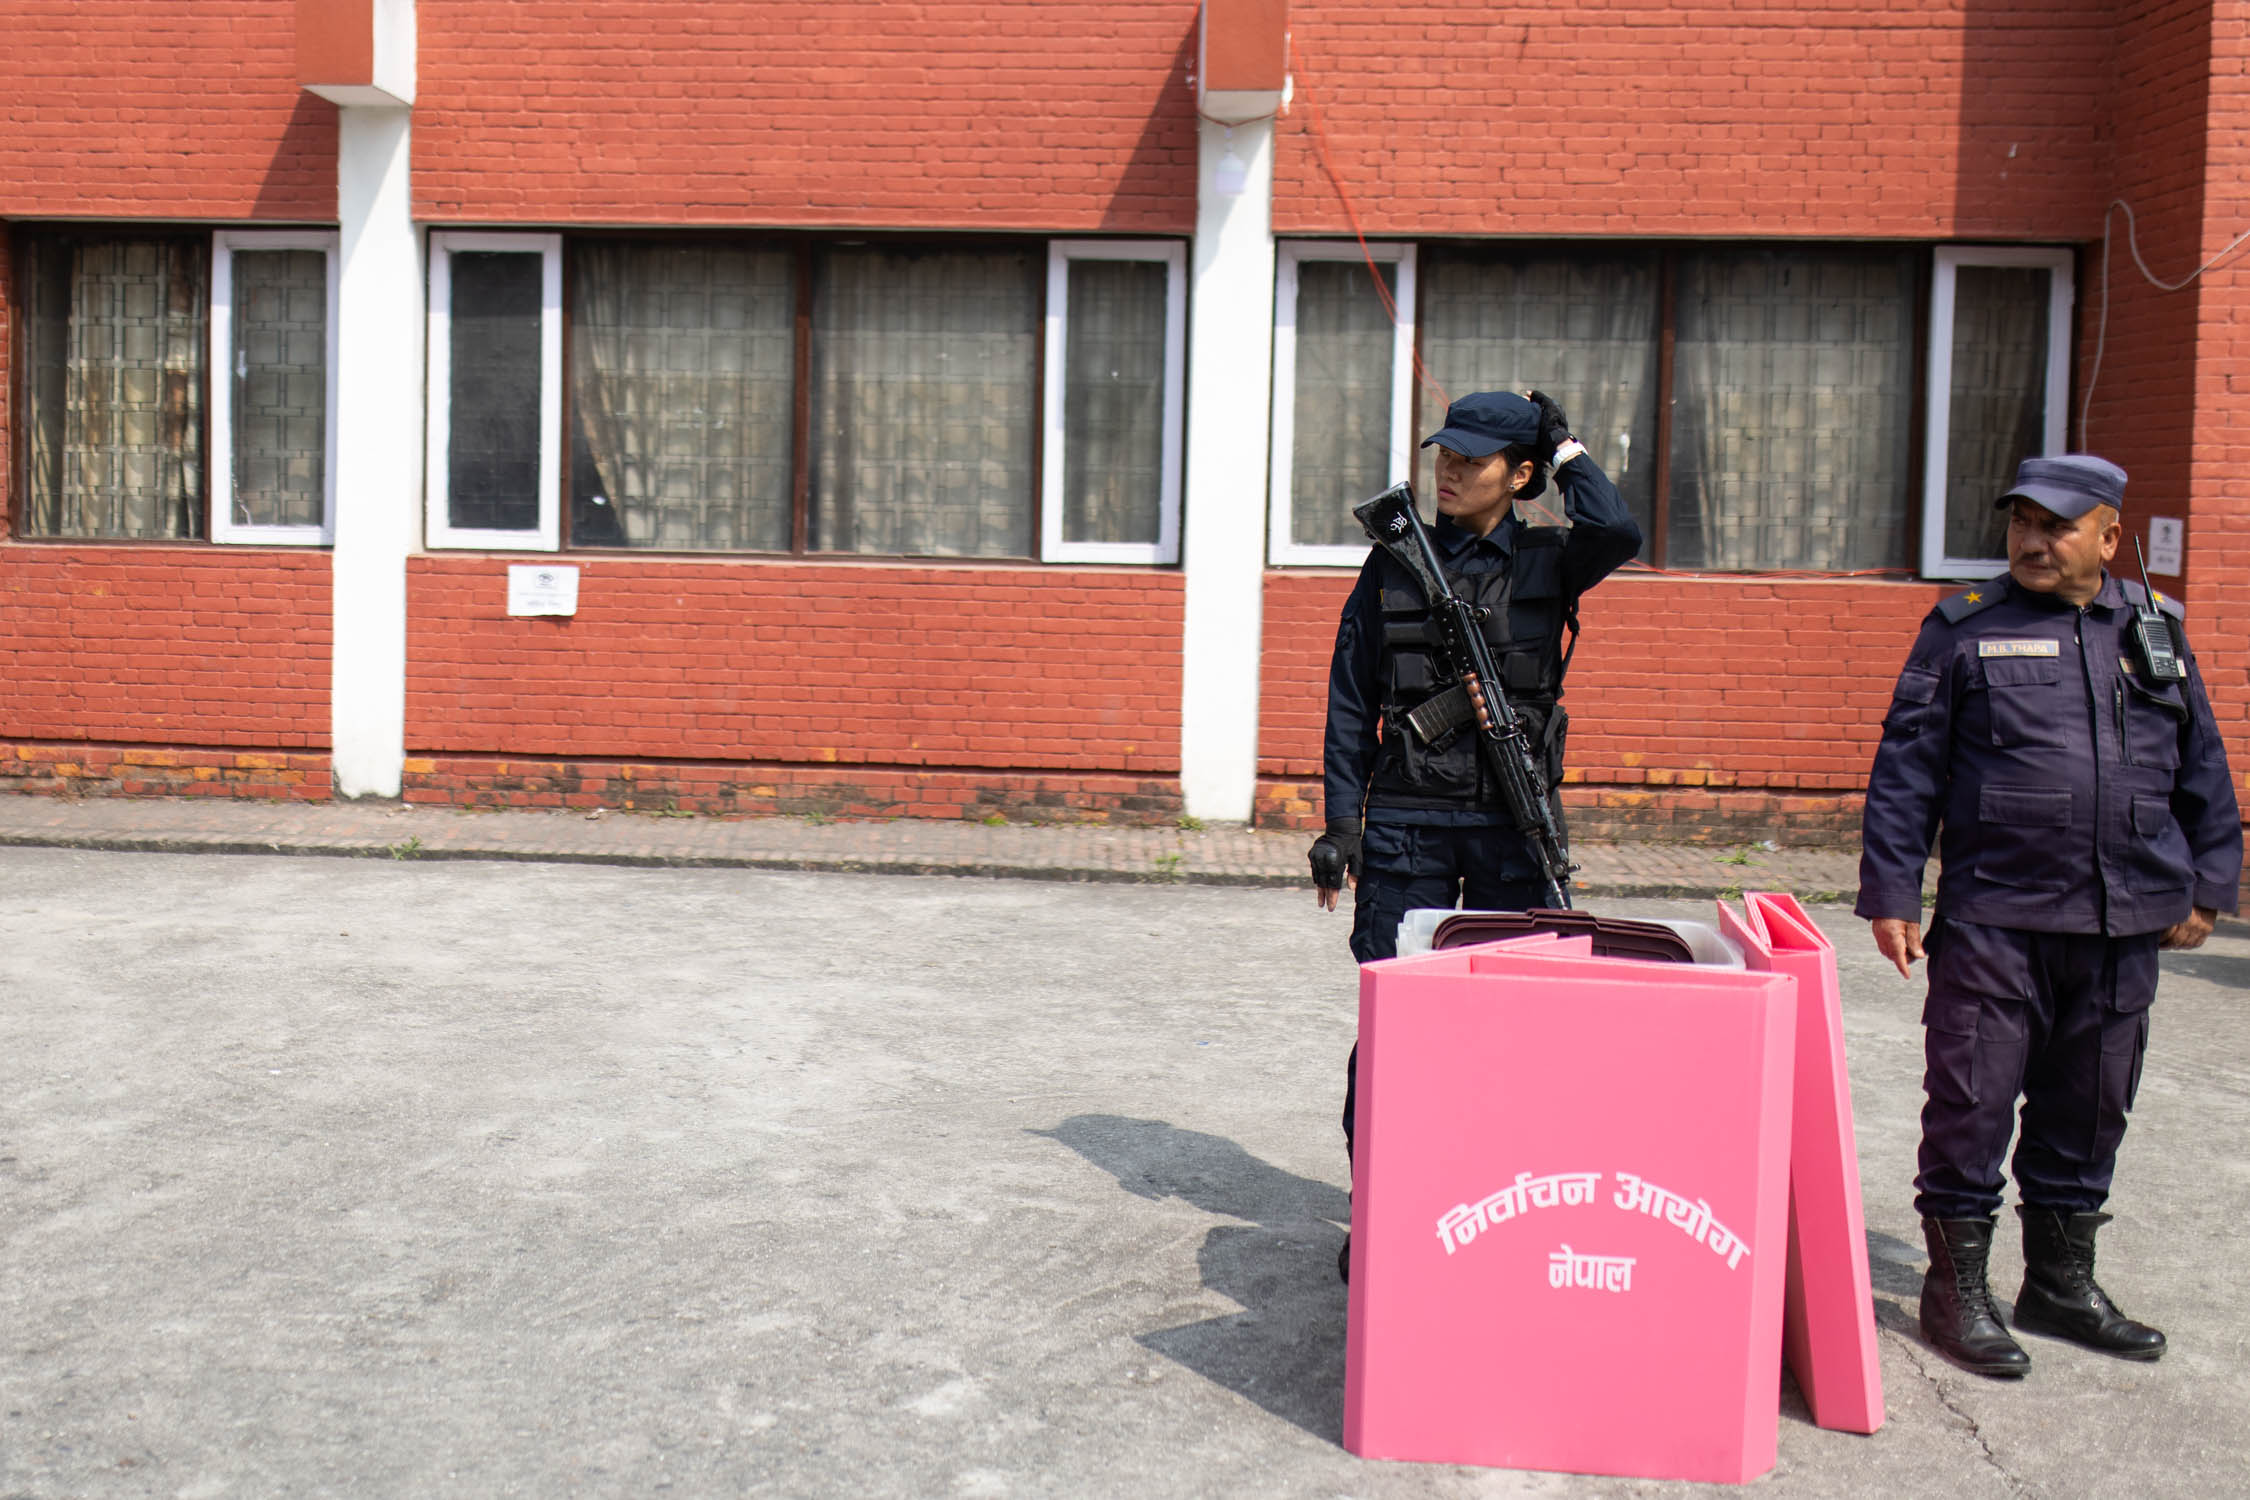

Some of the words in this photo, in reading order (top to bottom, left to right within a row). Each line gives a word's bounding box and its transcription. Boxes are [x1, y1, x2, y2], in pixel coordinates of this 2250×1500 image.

[2012, 643, 2048, 654] THAPA
[1436, 1171, 1602, 1255] निर्वाचन
[1613, 1171, 1751, 1270] आयोग
[1549, 1243, 1636, 1292] नेपाल
